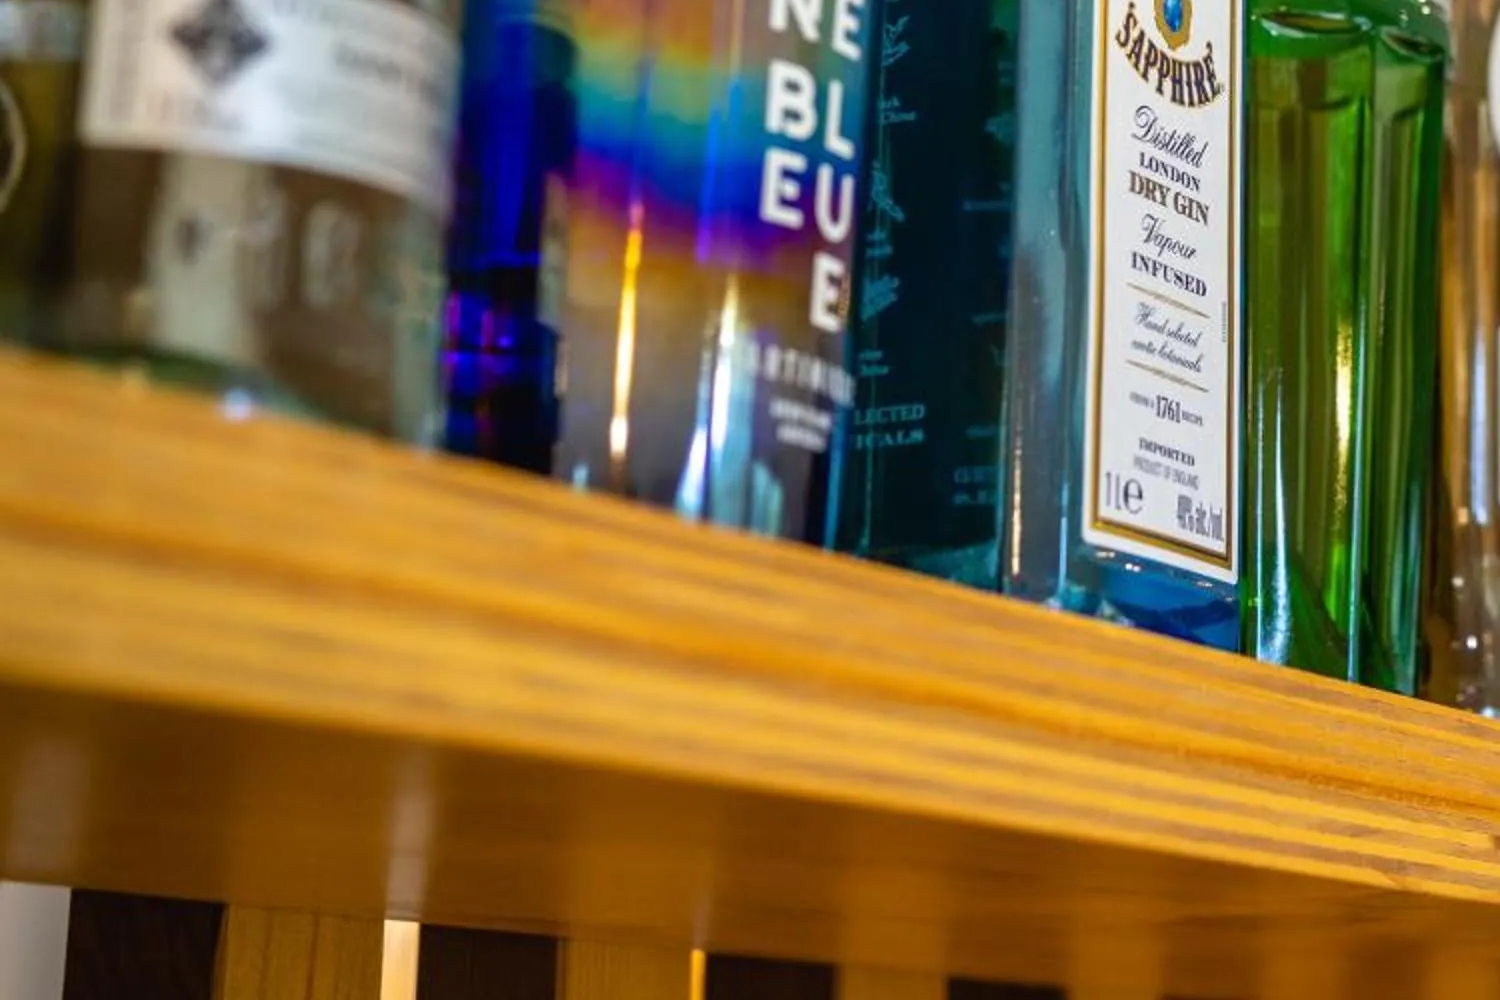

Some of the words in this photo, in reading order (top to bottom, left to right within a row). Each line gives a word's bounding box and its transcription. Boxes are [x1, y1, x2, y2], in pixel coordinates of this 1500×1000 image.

[1115, 1, 1225, 108] SAPPHIRE
[1131, 105, 1209, 168] Distilled
[1139, 151, 1201, 192] LONDON
[1128, 169, 1171, 208] DRY
[1172, 191, 1210, 226] GIN
[1141, 213, 1197, 260] Vapour
[1130, 251, 1208, 297] INFUSED
[1155, 394, 1181, 424] 1761
[1138, 436, 1196, 467] IMPORTED
